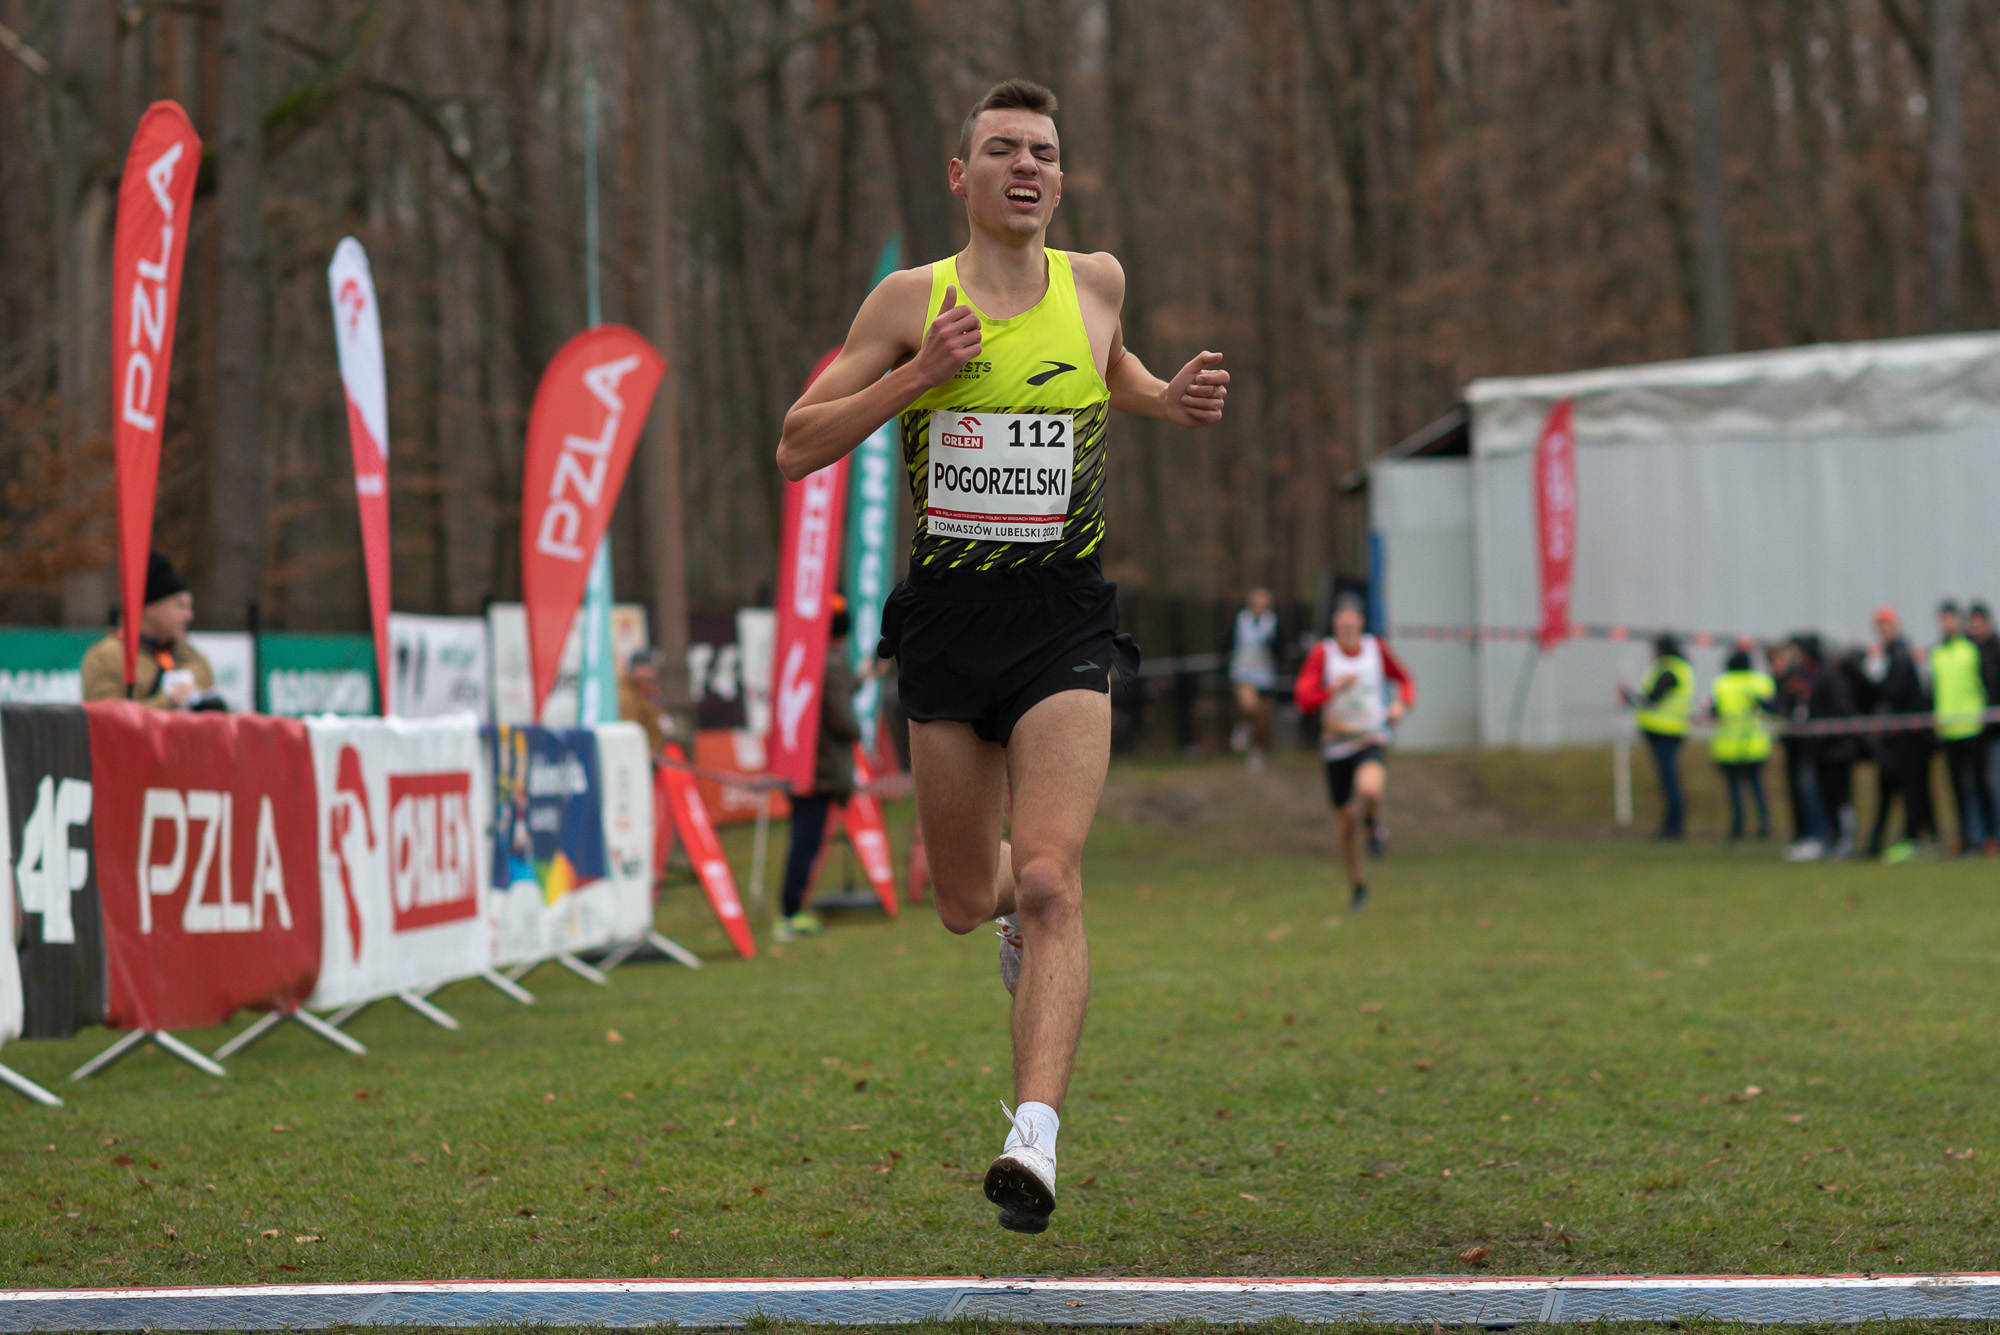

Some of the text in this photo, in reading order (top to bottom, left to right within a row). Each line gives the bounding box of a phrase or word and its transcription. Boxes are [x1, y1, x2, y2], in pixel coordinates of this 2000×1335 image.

[122, 141, 184, 433] PZLA
[960, 361, 992, 373] STS
[943, 435, 981, 448] ORLEN
[1008, 420, 1065, 448] 112
[536, 354, 641, 562] PZLA
[934, 462, 1066, 496] POGORZELSKI
[934, 521, 1059, 538] TOMASZÓW LUBELSKI 2021
[17, 774, 92, 944] 4F
[138, 788, 293, 934] PZLA
